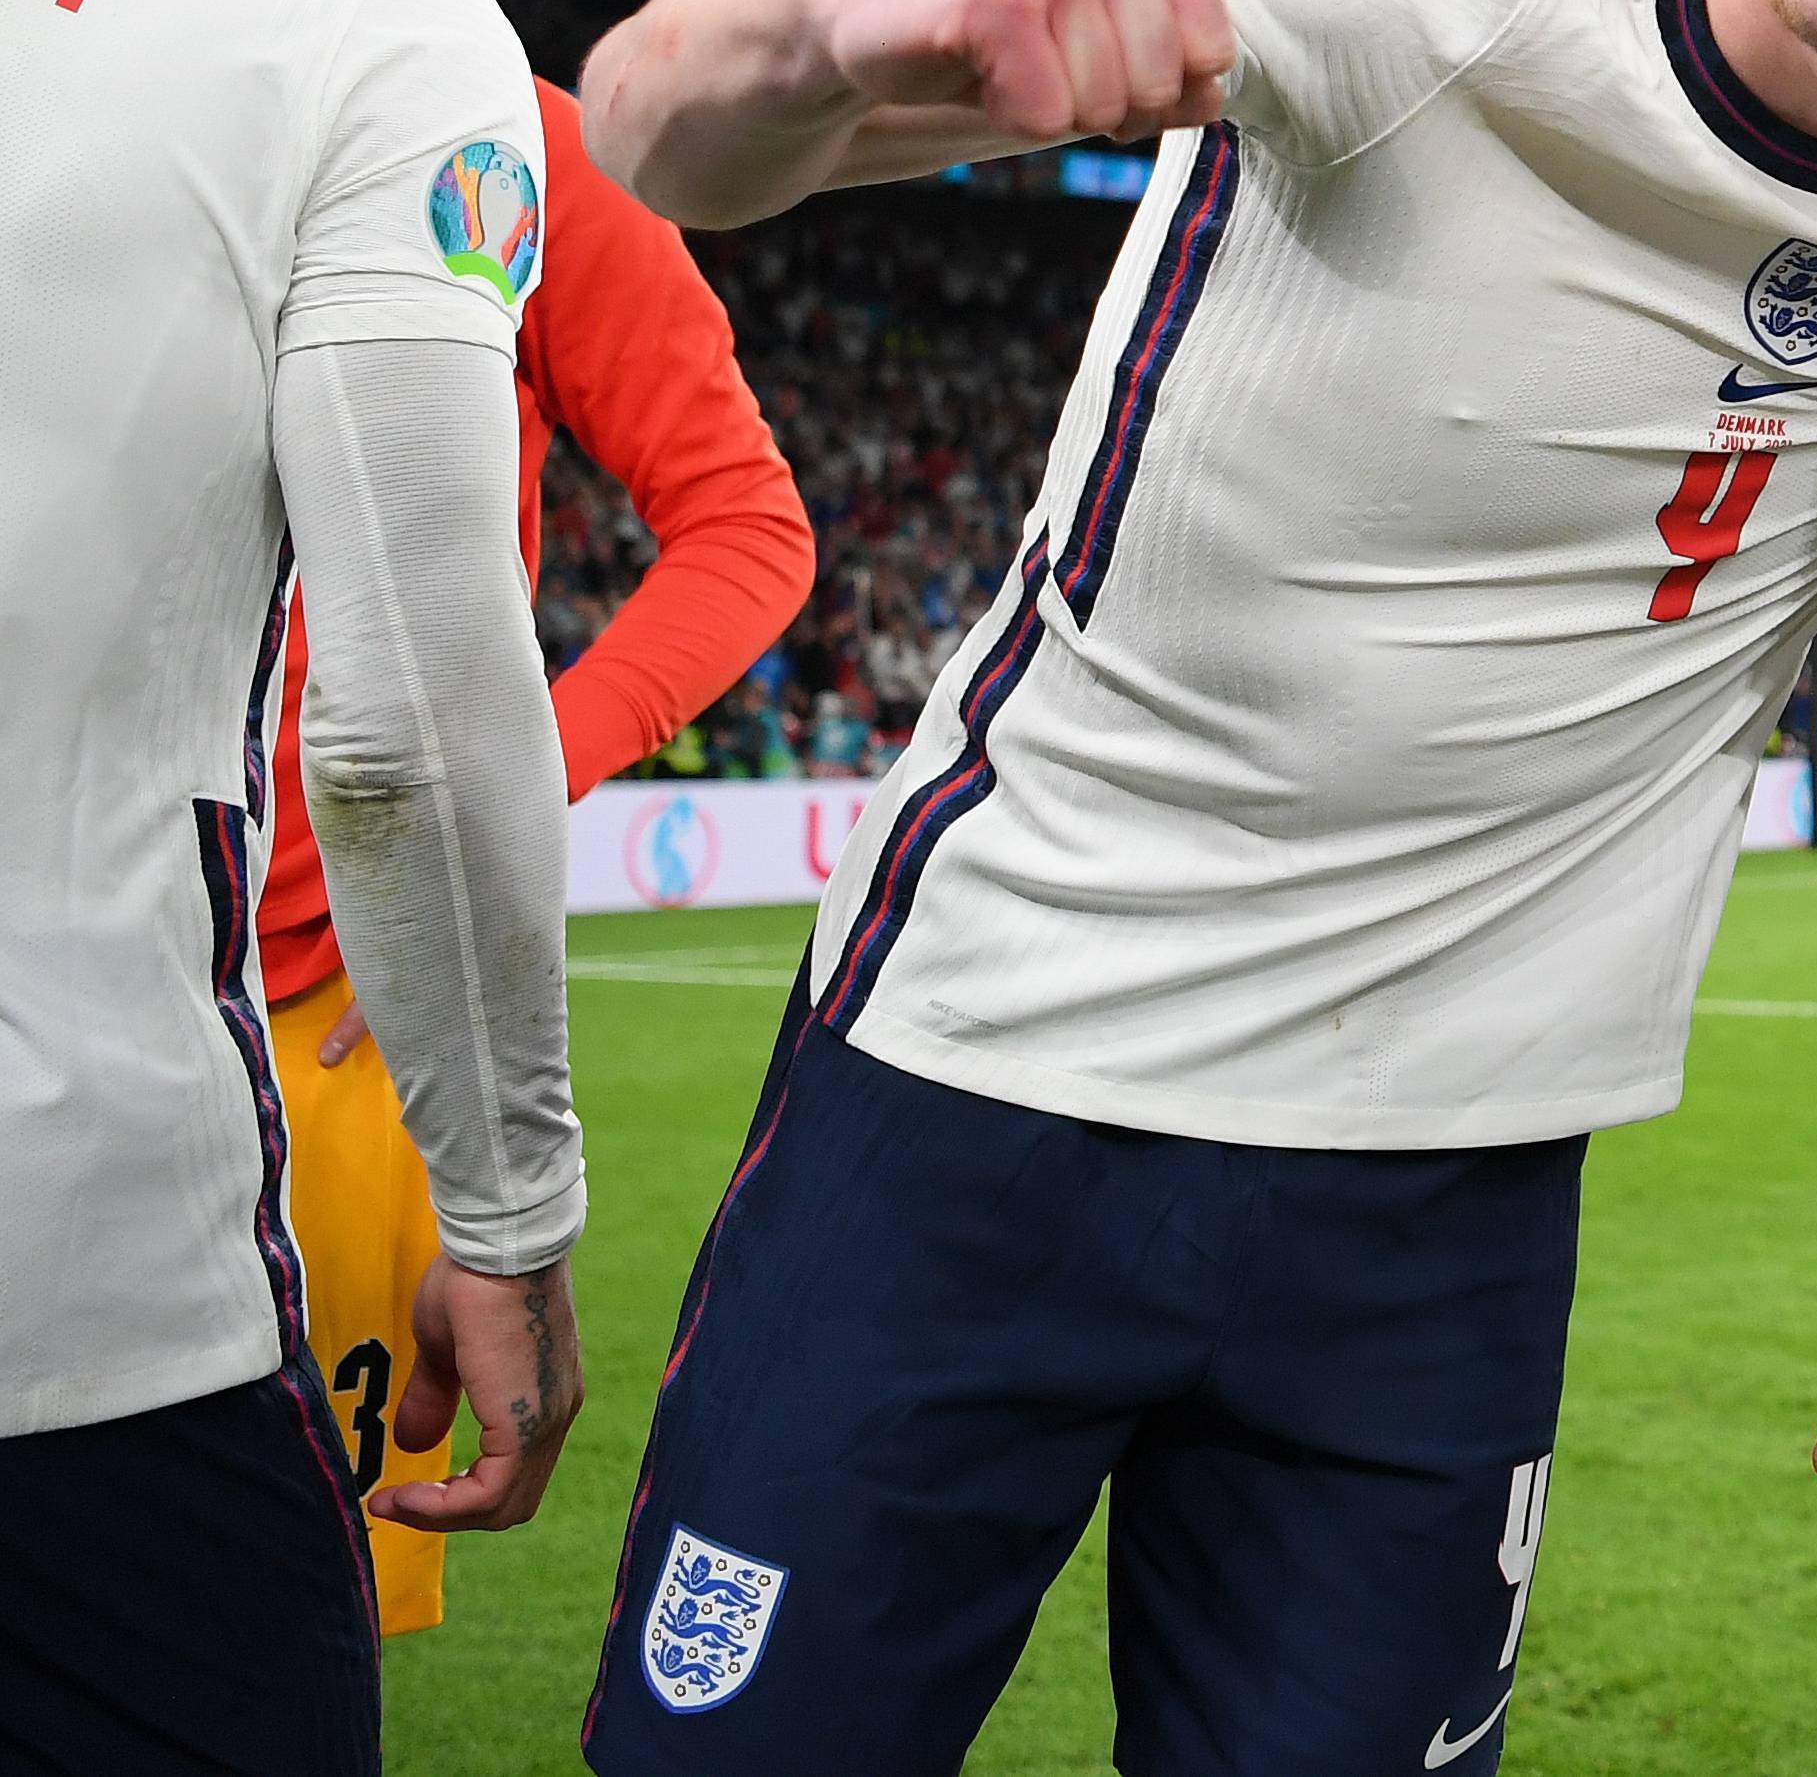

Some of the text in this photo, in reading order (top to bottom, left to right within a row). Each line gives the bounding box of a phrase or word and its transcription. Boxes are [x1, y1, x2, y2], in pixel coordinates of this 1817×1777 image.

[1708, 432, 1716, 448] 7
[1721, 434, 1756, 451] JULY
[1716, 413, 1787, 436] DENMARK
[1647, 450, 1778, 622] 4
[1498, 1452, 1552, 1671] 4
